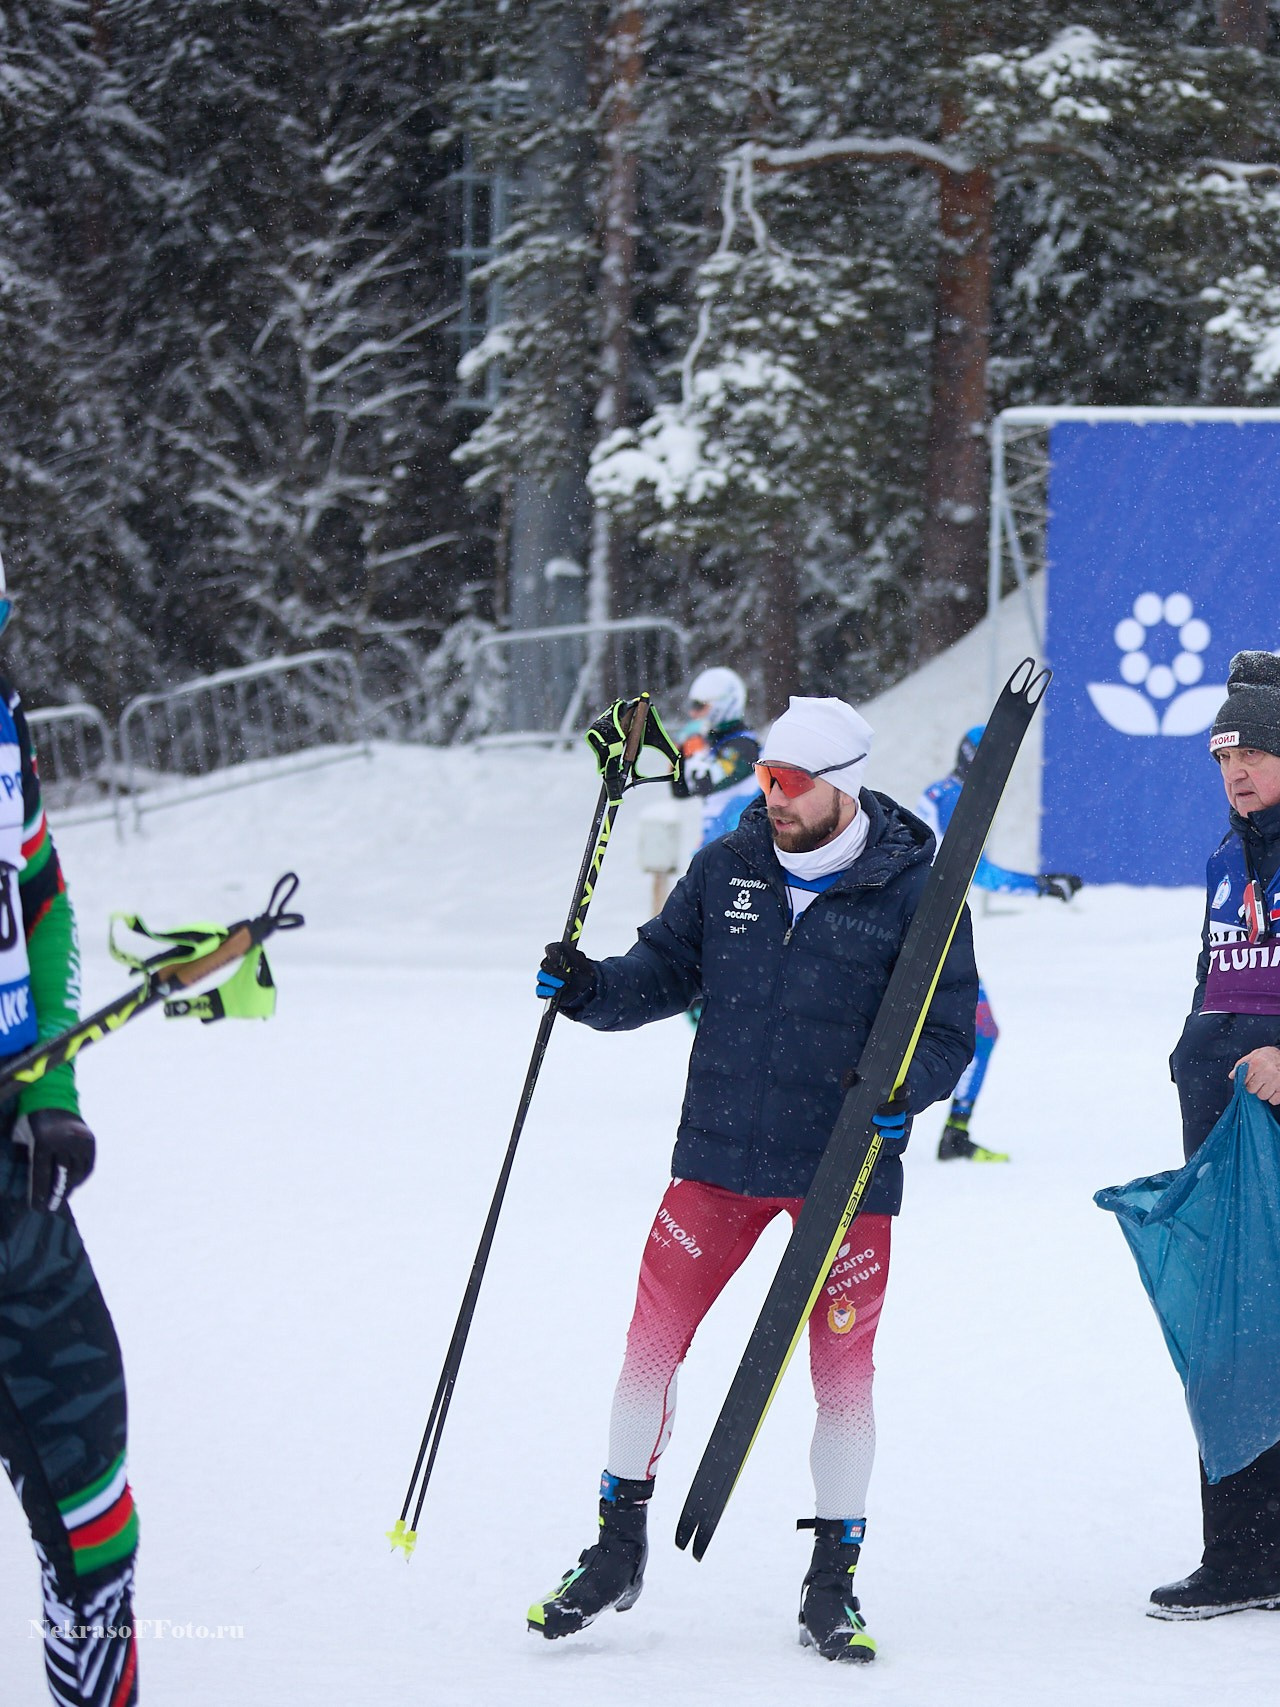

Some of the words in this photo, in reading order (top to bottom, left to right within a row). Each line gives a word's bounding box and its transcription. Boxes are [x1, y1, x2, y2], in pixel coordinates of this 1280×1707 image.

[729, 877, 767, 891] ЛУКОЙЛ
[724, 910, 759, 922] ФОСАГРО
[824, 910, 896, 942] BIVIUM
[658, 1208, 703, 1260] ЛУКОЙЛ
[826, 1262, 881, 1296] BIVIUM
